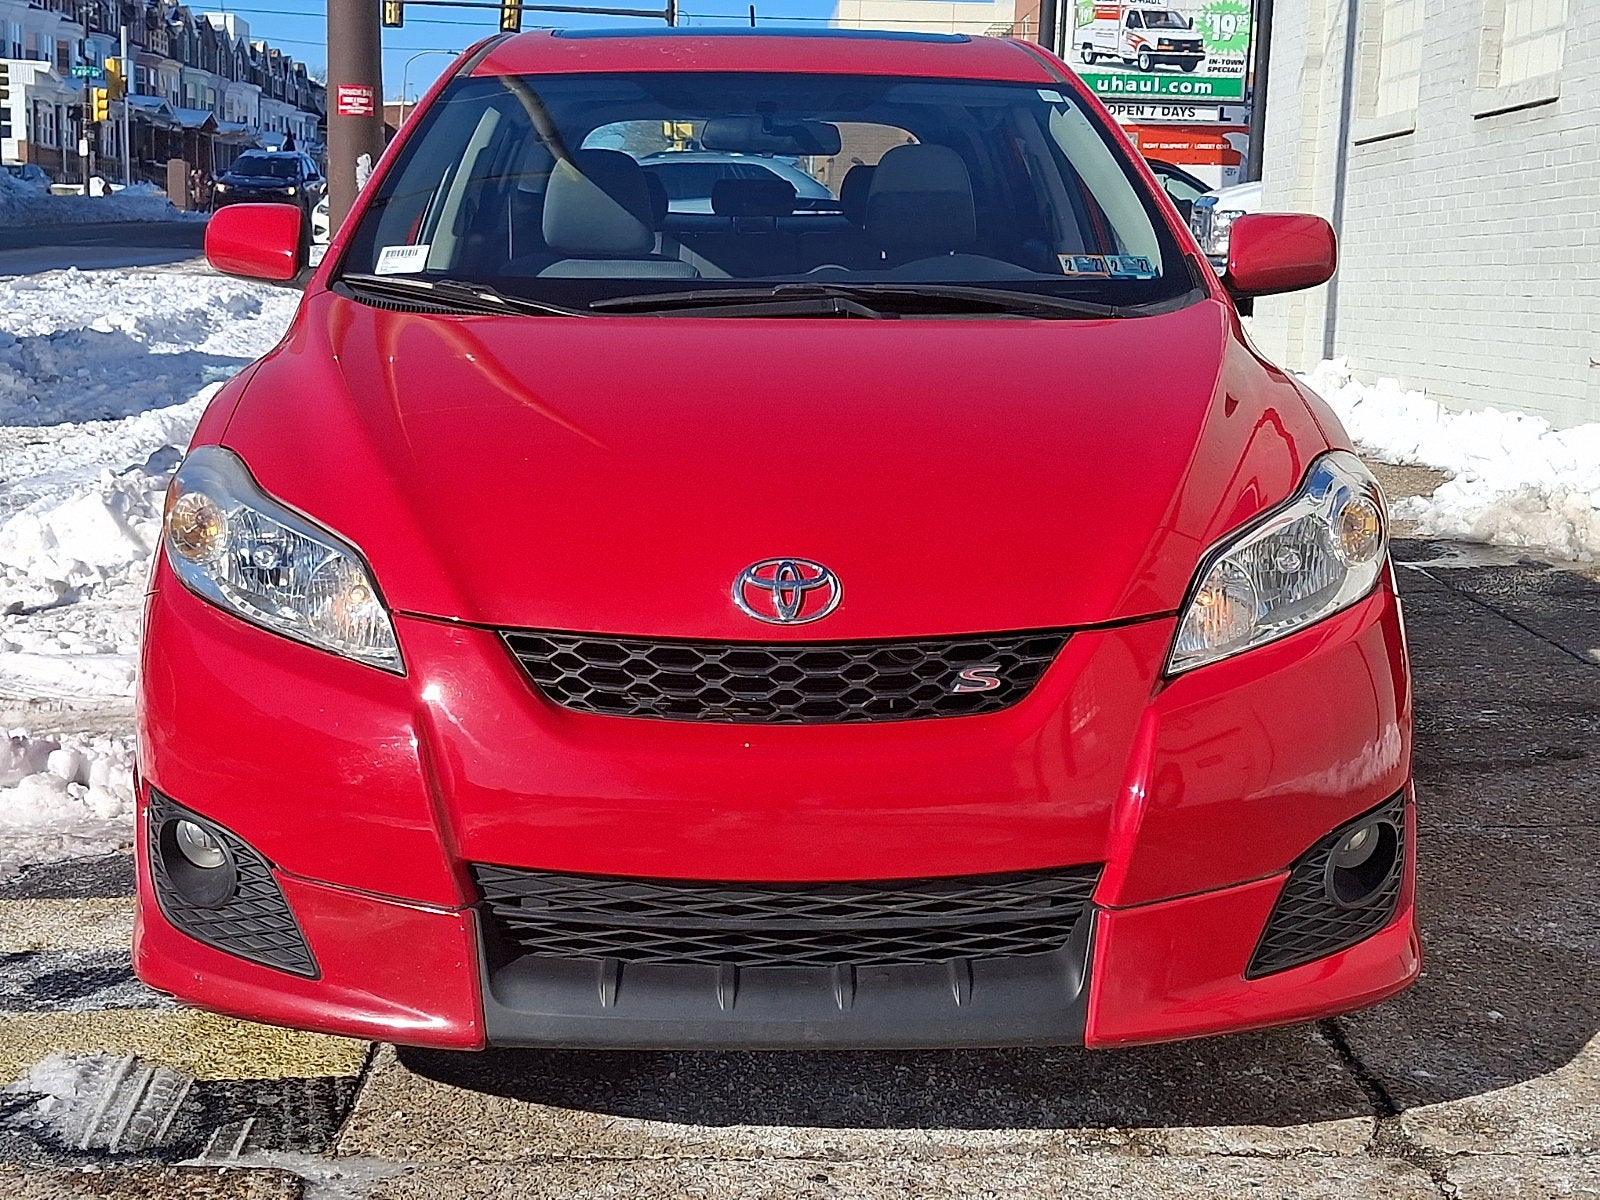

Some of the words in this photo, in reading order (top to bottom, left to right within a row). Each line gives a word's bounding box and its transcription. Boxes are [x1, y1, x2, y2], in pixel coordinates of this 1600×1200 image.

[1096, 76, 1213, 94] uhaul.com
[1107, 104, 1145, 116] OPEN
[1150, 105, 1157, 116] 7
[1161, 106, 1196, 117] DAYS
[953, 665, 1001, 692] S
